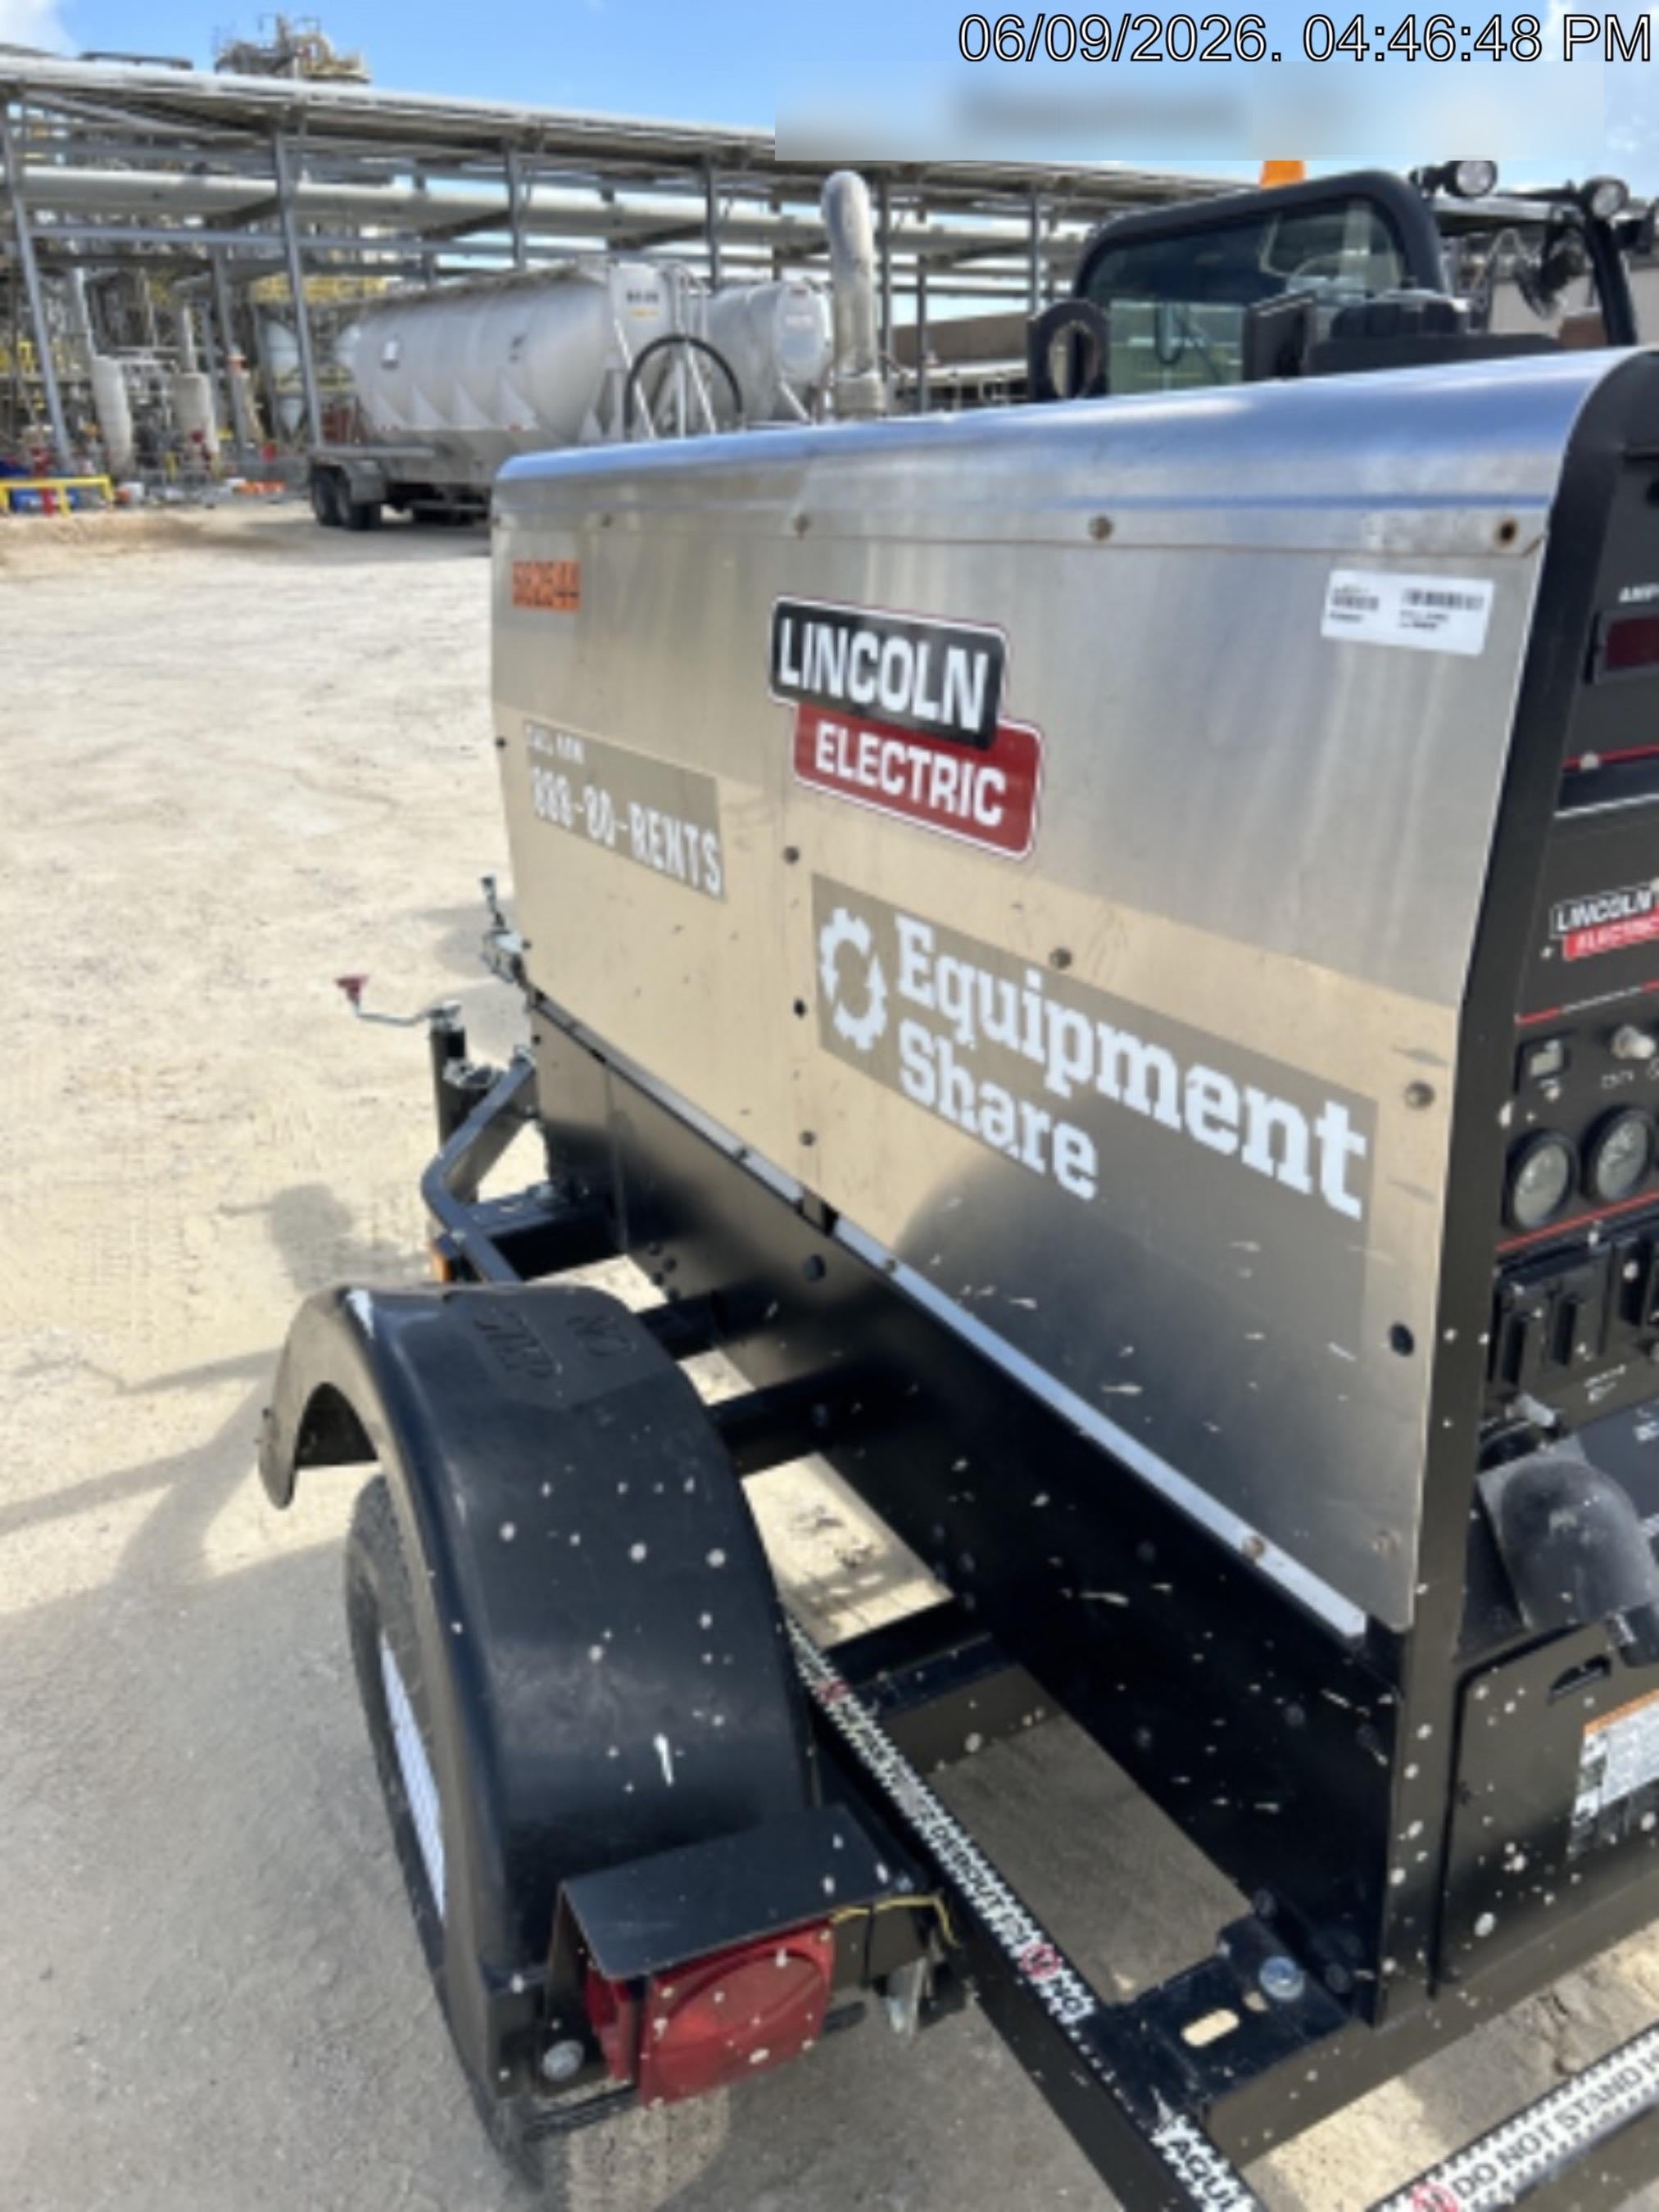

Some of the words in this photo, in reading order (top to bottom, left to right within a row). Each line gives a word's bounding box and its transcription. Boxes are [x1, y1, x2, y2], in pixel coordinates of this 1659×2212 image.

[778, 617, 989, 732] LINCOLN
[814, 720, 1007, 827] ELECTRIC
[895, 912, 1366, 1219] Equipment
[900, 1018, 1097, 1201] Share
[1451, 2161, 1498, 2198] DO
[1495, 2123, 1556, 2169] NOT
[1555, 2065, 1643, 2131] STAND
